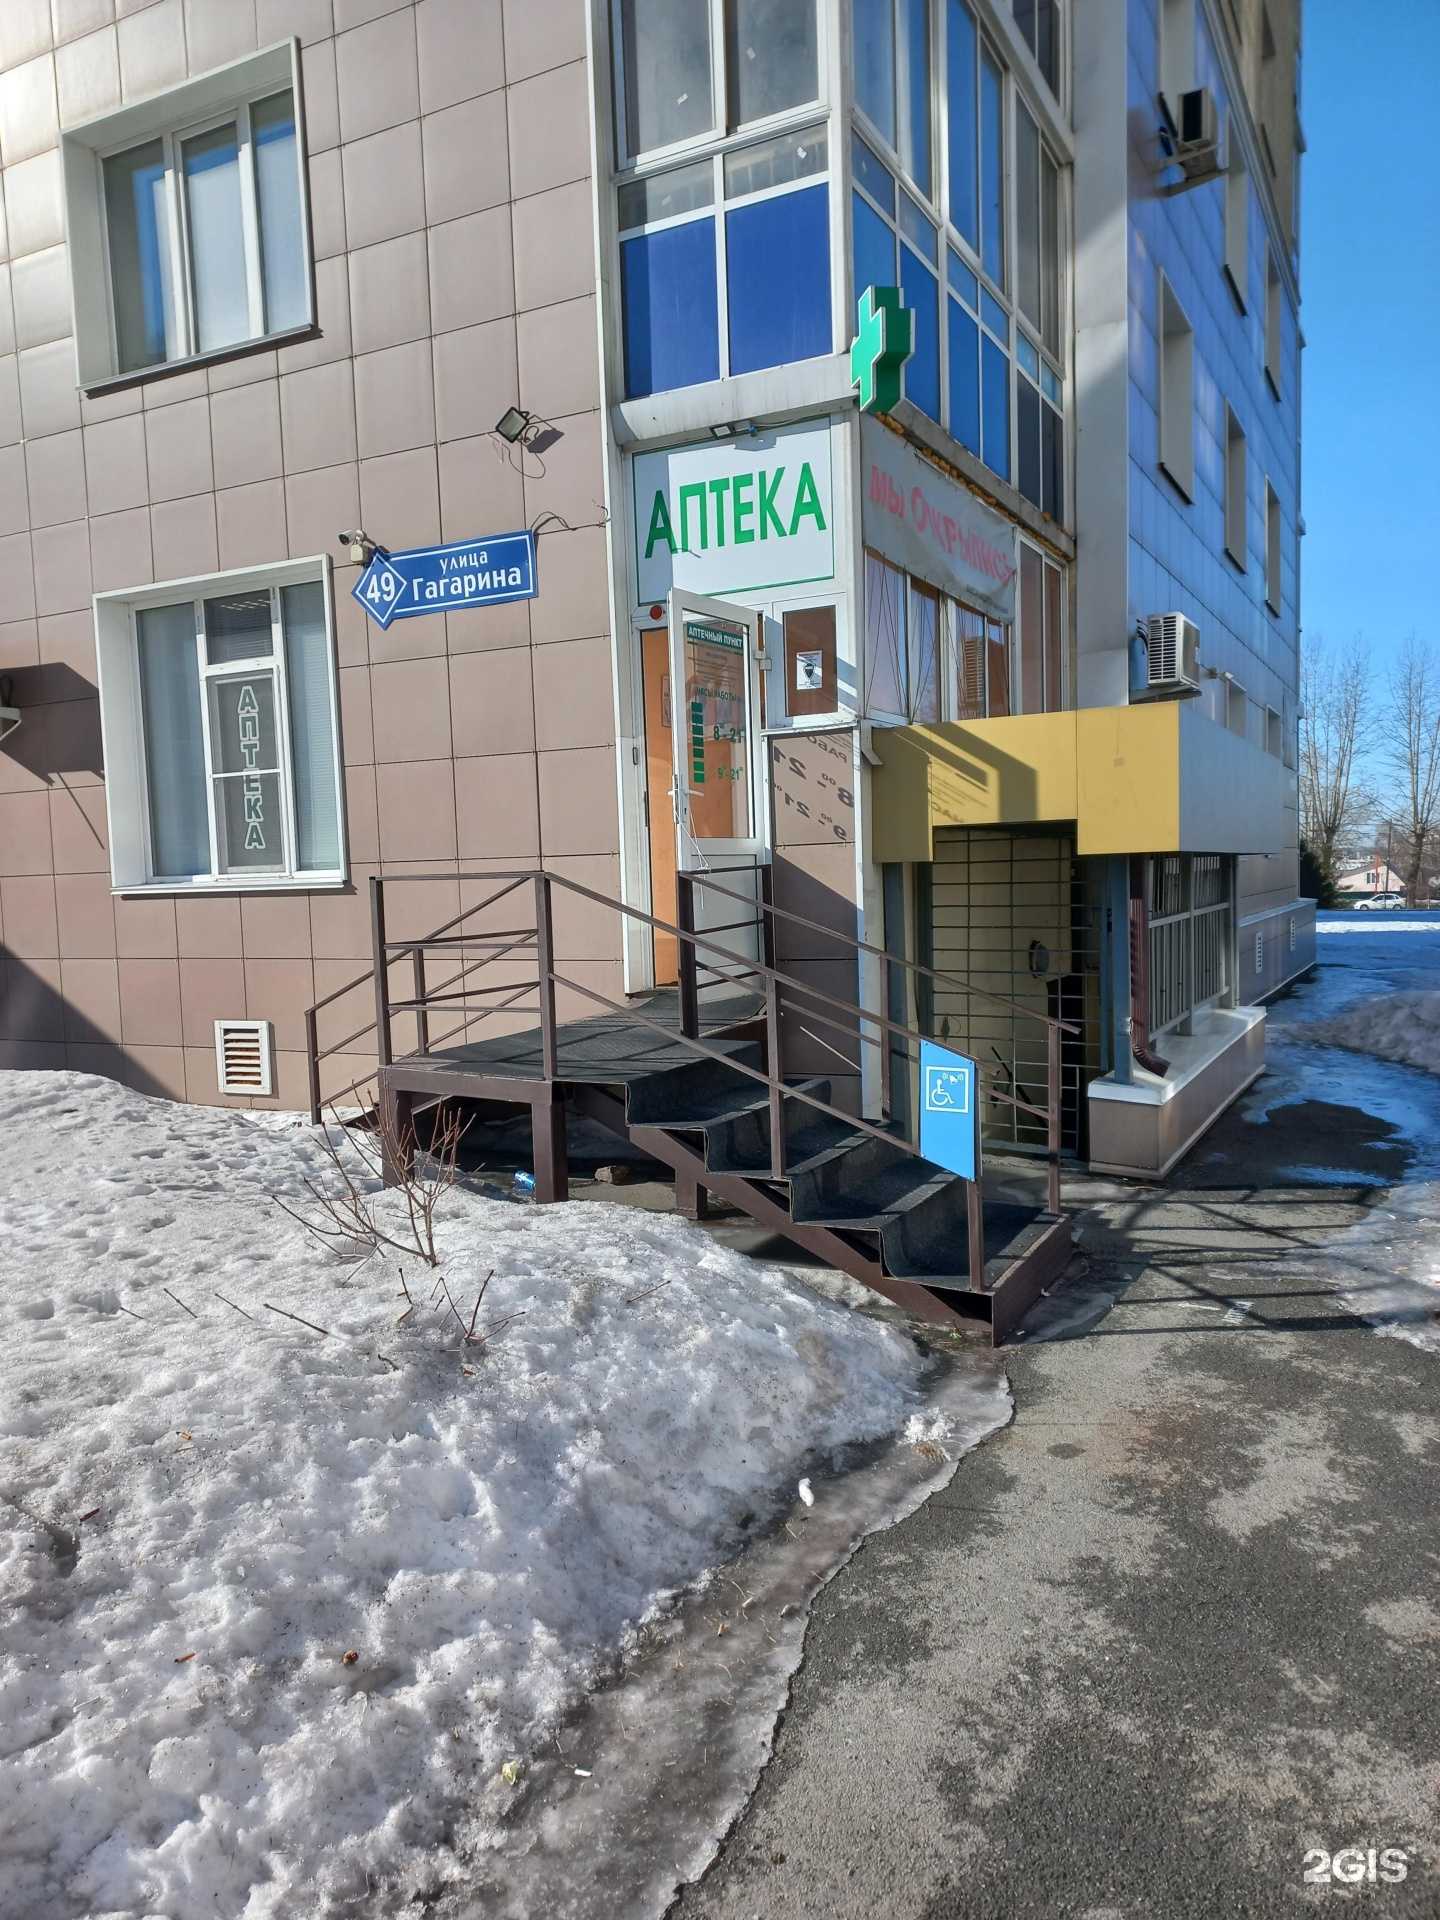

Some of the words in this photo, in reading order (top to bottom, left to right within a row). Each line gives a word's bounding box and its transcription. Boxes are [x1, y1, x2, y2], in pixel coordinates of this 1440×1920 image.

[645, 462, 827, 559] АПТЕКА
[440, 551, 488, 575] улица
[366, 572, 396, 604] 49
[412, 567, 522, 601] Гагарина
[688, 626, 723, 643] АПТЕЧНЫЙ
[237, 685, 266, 849] АПТЕКА
